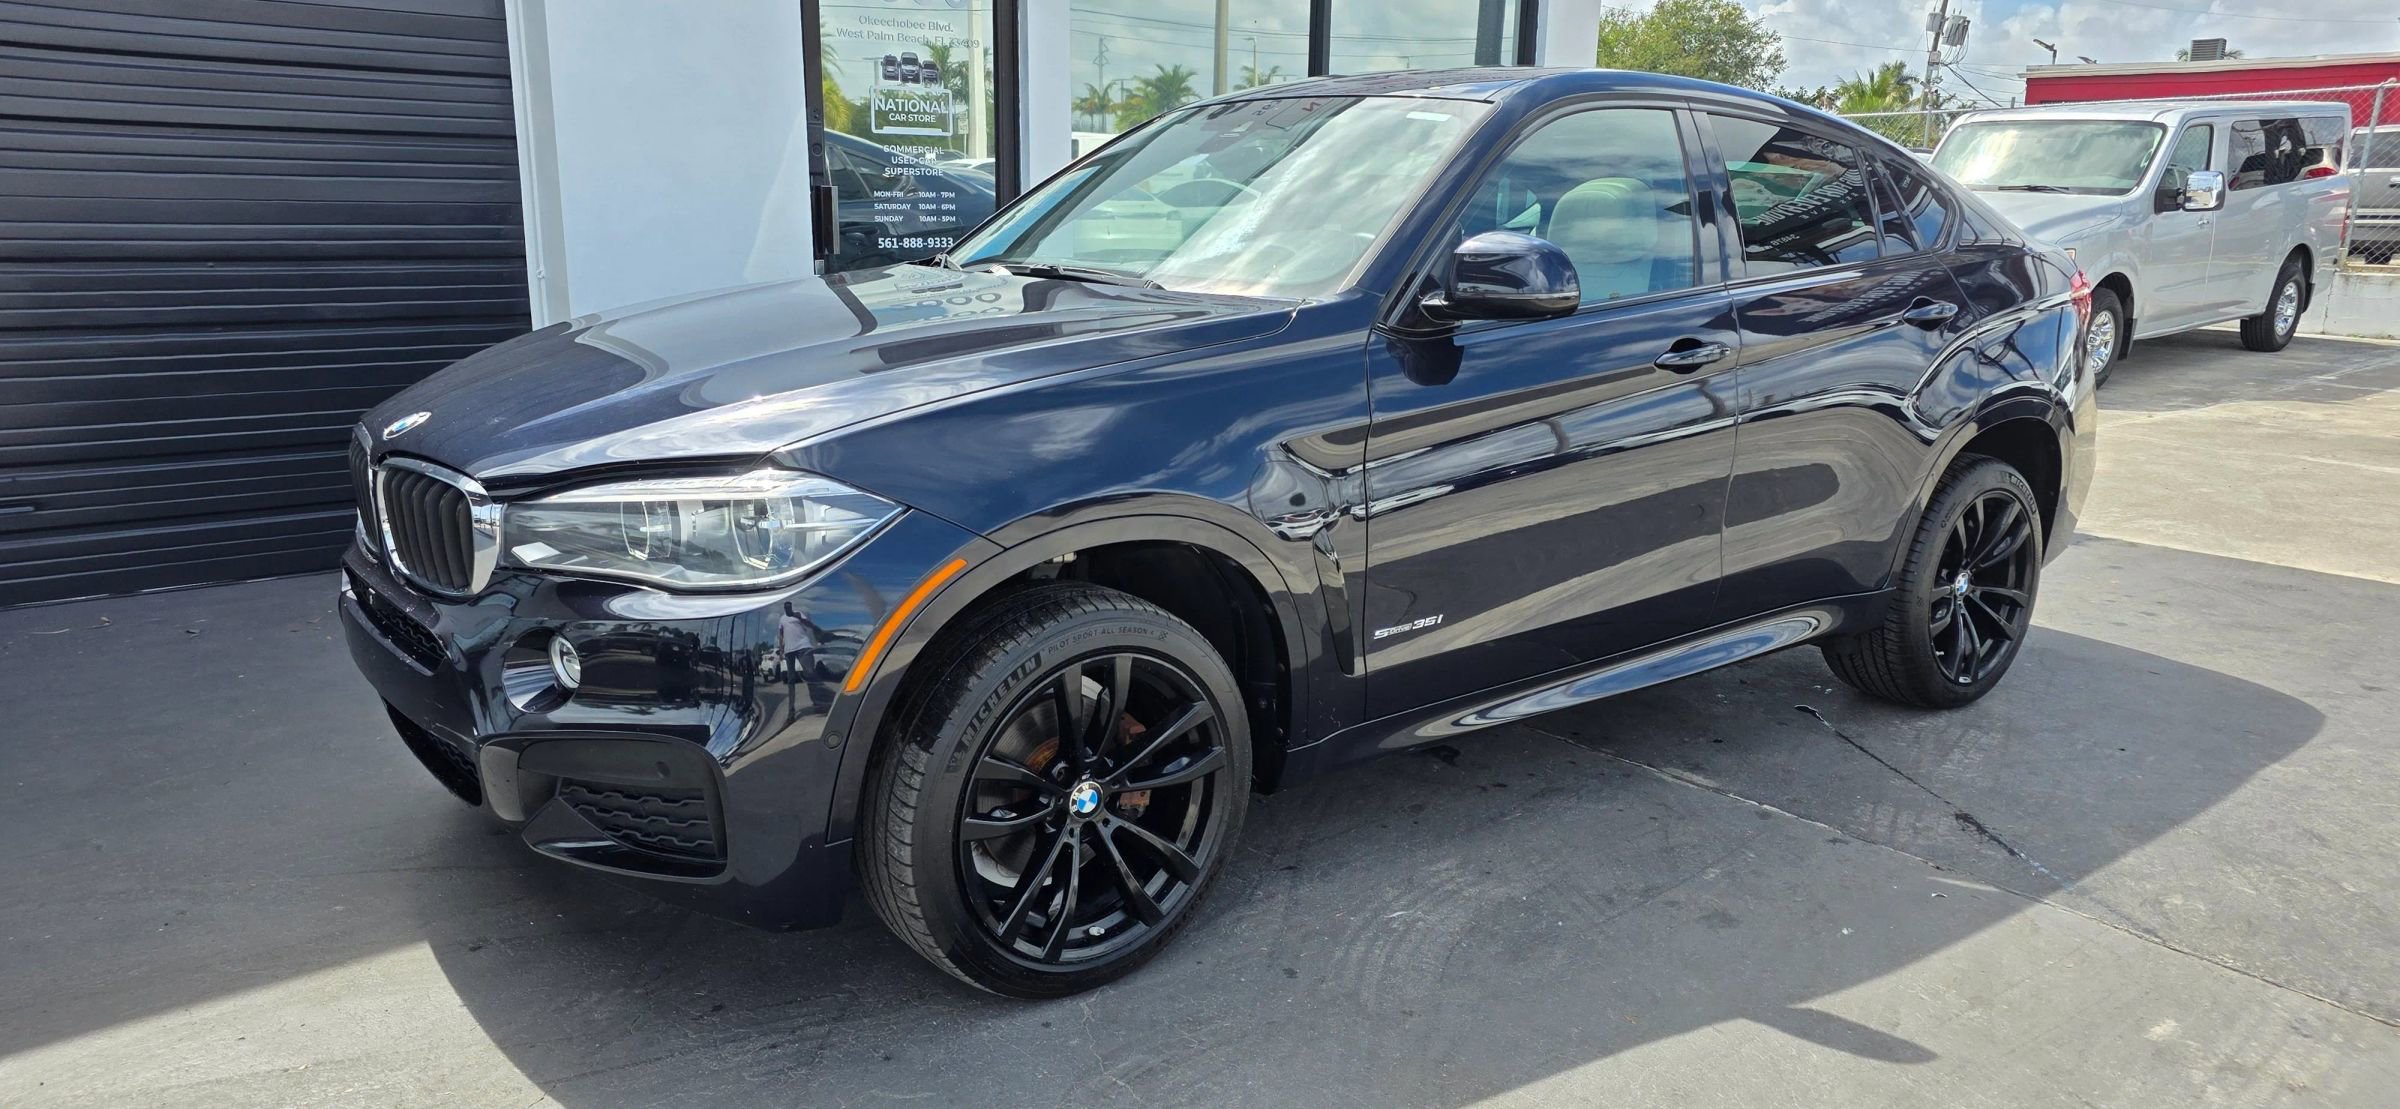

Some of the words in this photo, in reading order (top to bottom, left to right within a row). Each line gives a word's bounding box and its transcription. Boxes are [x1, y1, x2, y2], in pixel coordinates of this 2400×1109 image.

[859, 15, 926, 30] Okeechobee
[929, 21, 954, 32] Blvd.
[836, 28, 865, 39] West
[867, 30, 894, 41] Palm
[875, 98, 949, 114] NATIONAL
[889, 113, 906, 121] CAR
[908, 114, 937, 123] STORE
[883, 144, 945, 155] COMMERCIAL
[892, 156, 917, 165] USED
[884, 167, 944, 177] SUPERSTORE
[874, 190, 904, 198] MON-FRI
[877, 237, 954, 249] 561-888-9333
[1047, 639, 1071, 655] PILOT
[1073, 630, 1098, 644] SPORT
[1118, 626, 1148, 635] SEASON
[961, 654, 1038, 748] MICHELIN
